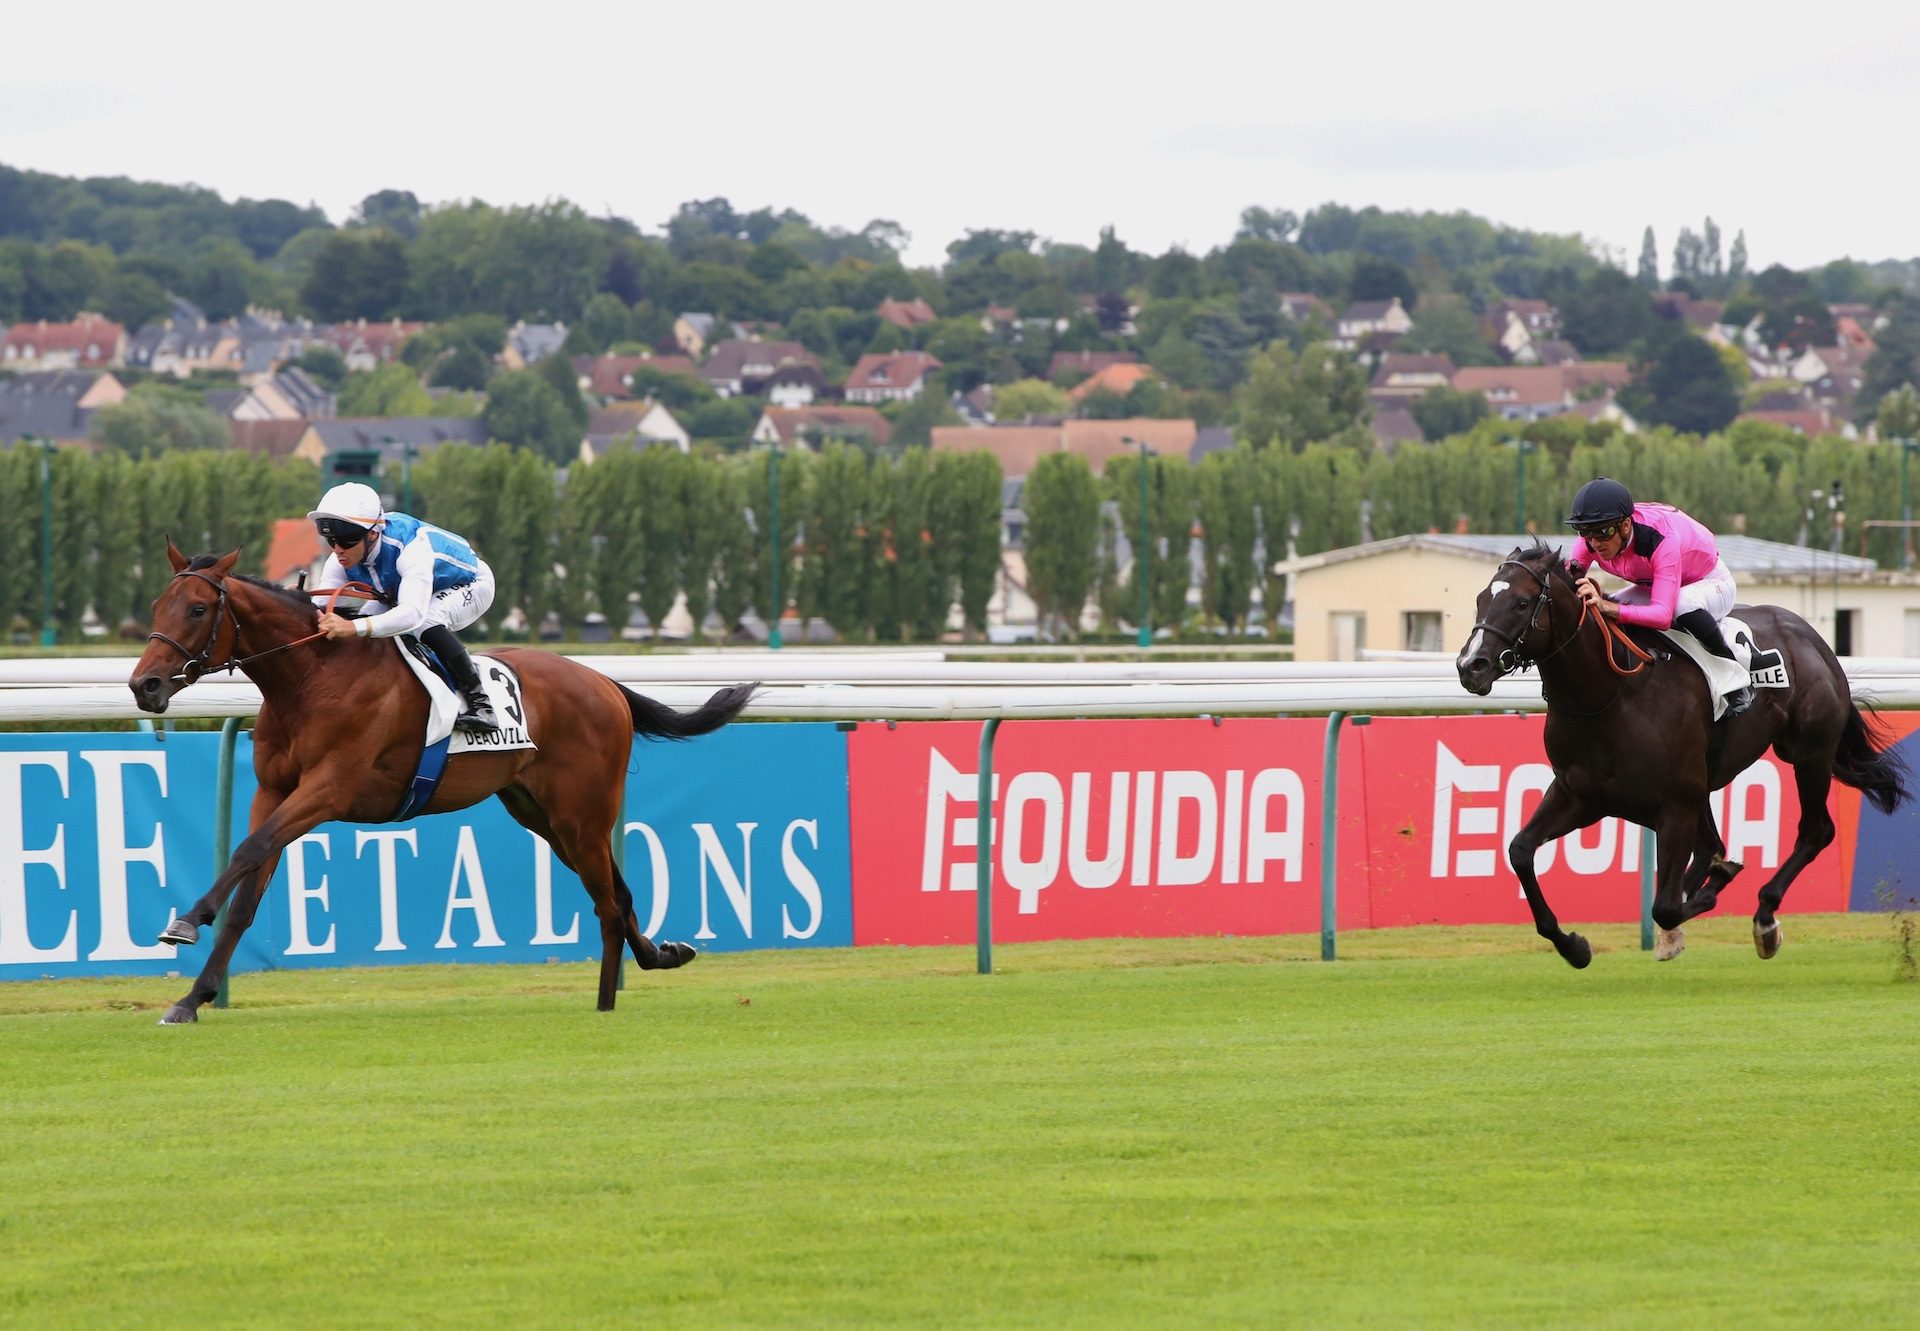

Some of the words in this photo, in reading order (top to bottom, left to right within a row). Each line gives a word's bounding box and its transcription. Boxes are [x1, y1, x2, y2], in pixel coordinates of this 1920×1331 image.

[490, 667, 522, 726] 3
[1735, 631, 1781, 671] 2
[921, 746, 1305, 914] EQUIDIA
[1430, 739, 1782, 899] EQUA
